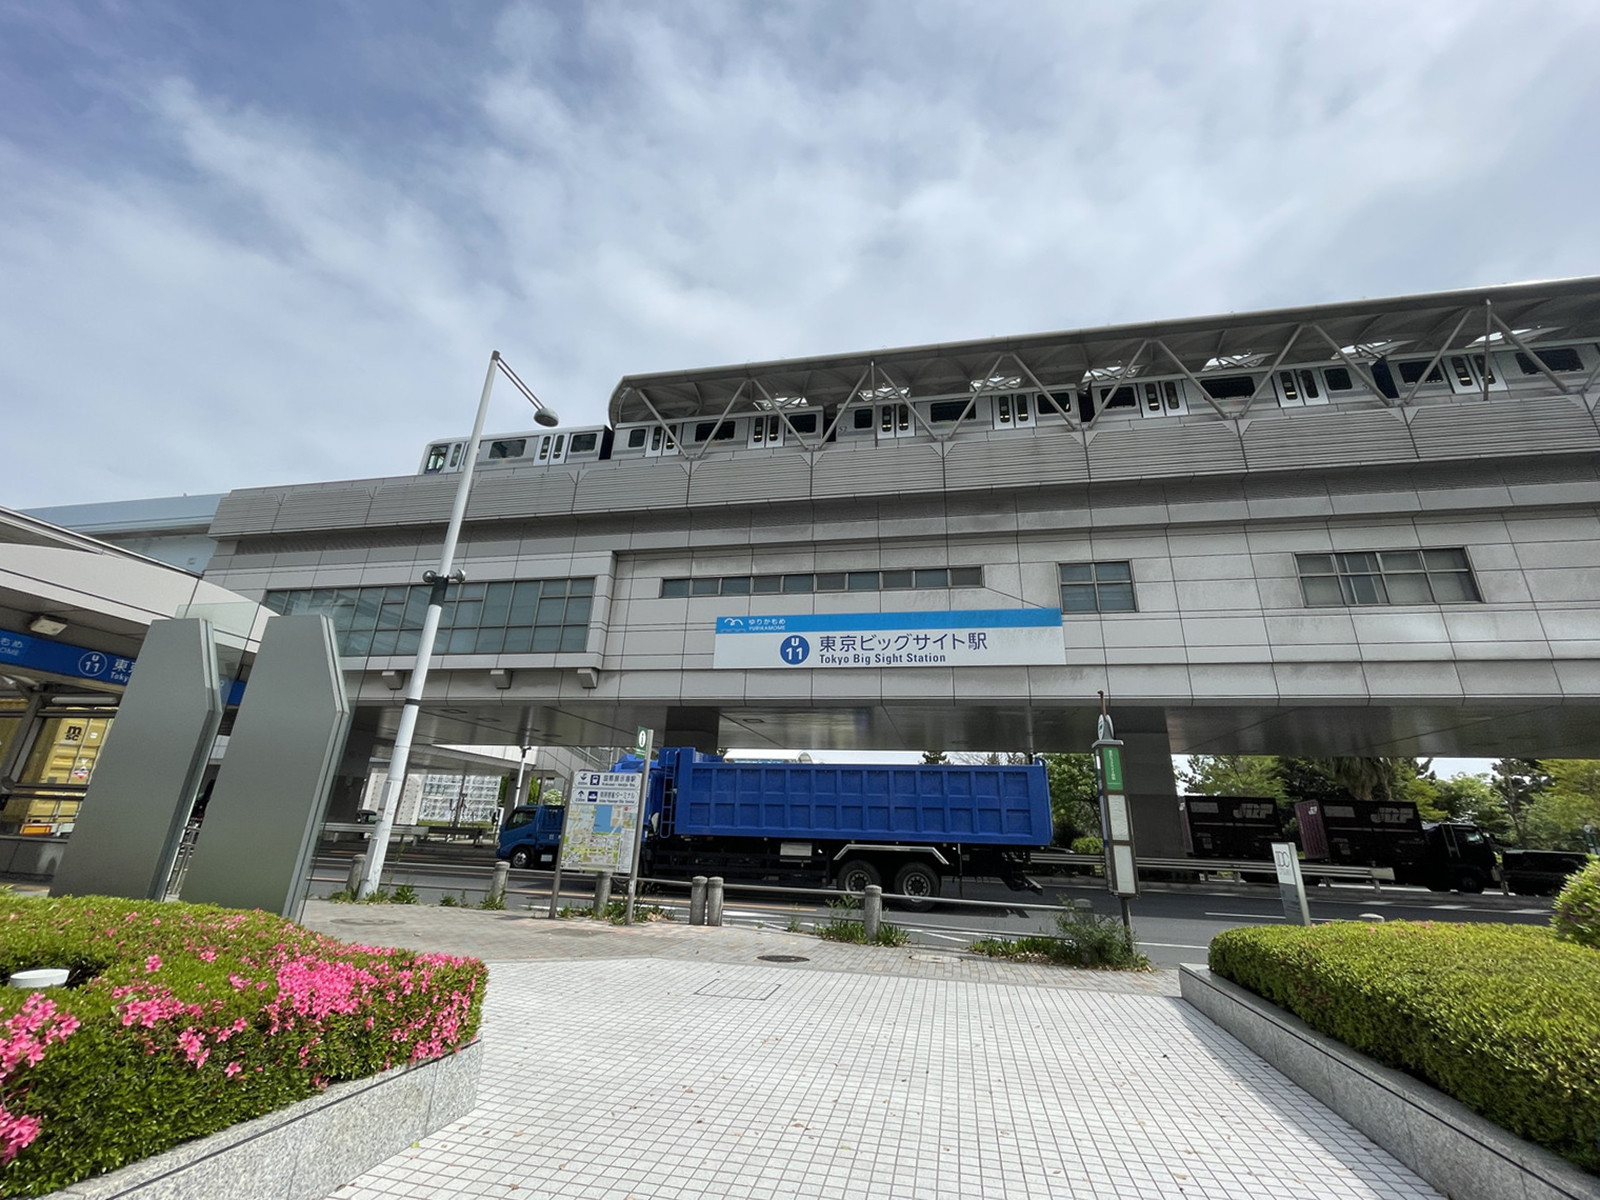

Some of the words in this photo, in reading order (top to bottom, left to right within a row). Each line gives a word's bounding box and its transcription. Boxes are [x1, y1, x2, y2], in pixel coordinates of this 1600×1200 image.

[748, 618, 786, 626] ゆりかもめ
[790, 637, 800, 647] U
[818, 632, 988, 653] 東京ビッグサイト駅
[785, 647, 804, 661] 11
[819, 654, 850, 666] Tokyo
[853, 653, 871, 666] Big
[874, 653, 903, 665] Sight
[906, 652, 946, 663] Station
[84, 661, 100, 673] 11
